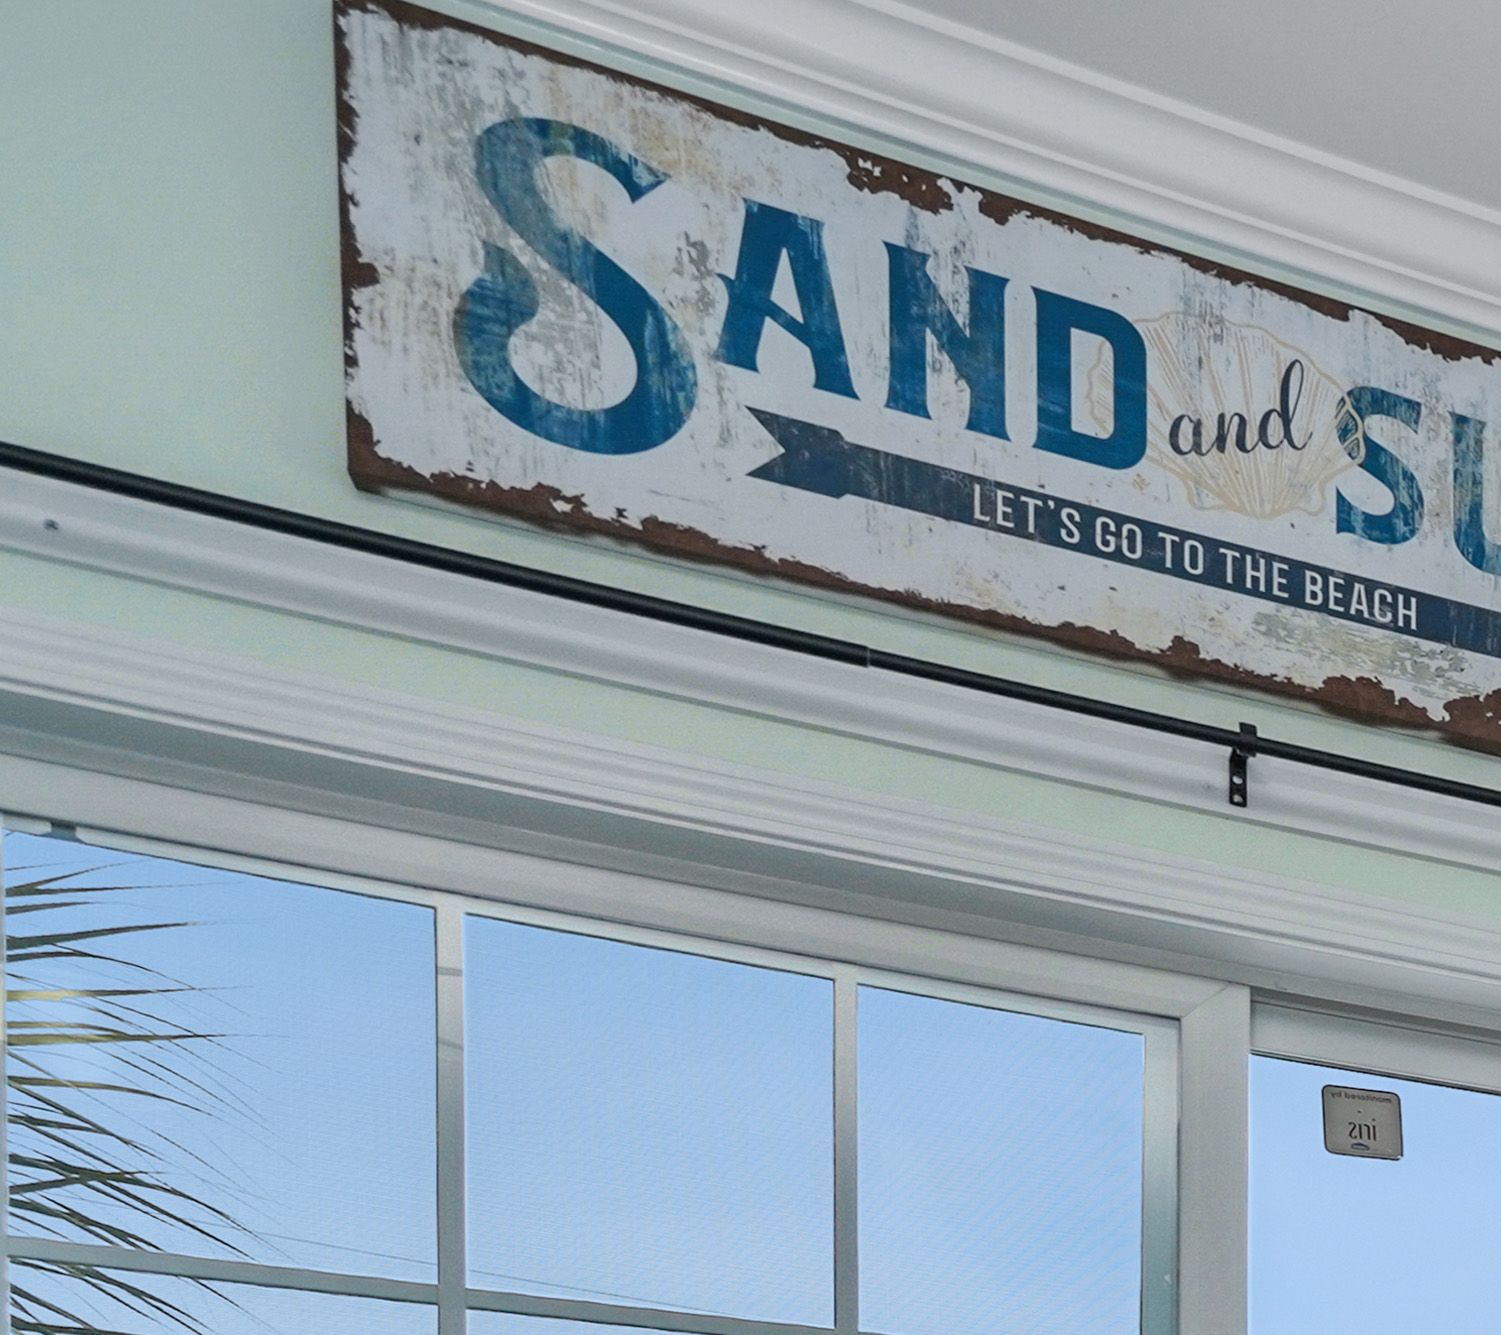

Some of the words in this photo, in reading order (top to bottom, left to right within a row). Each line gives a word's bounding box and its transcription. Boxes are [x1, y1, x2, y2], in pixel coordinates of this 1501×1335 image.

[452, 116, 1148, 472] SAND
[1167, 360, 1311, 461] and
[973, 483, 1081, 545] LET'S
[1095, 515, 1143, 560] GO
[1158, 531, 1205, 575] TO
[1219, 547, 1290, 598] THE
[1305, 569, 1418, 630] BEACH
